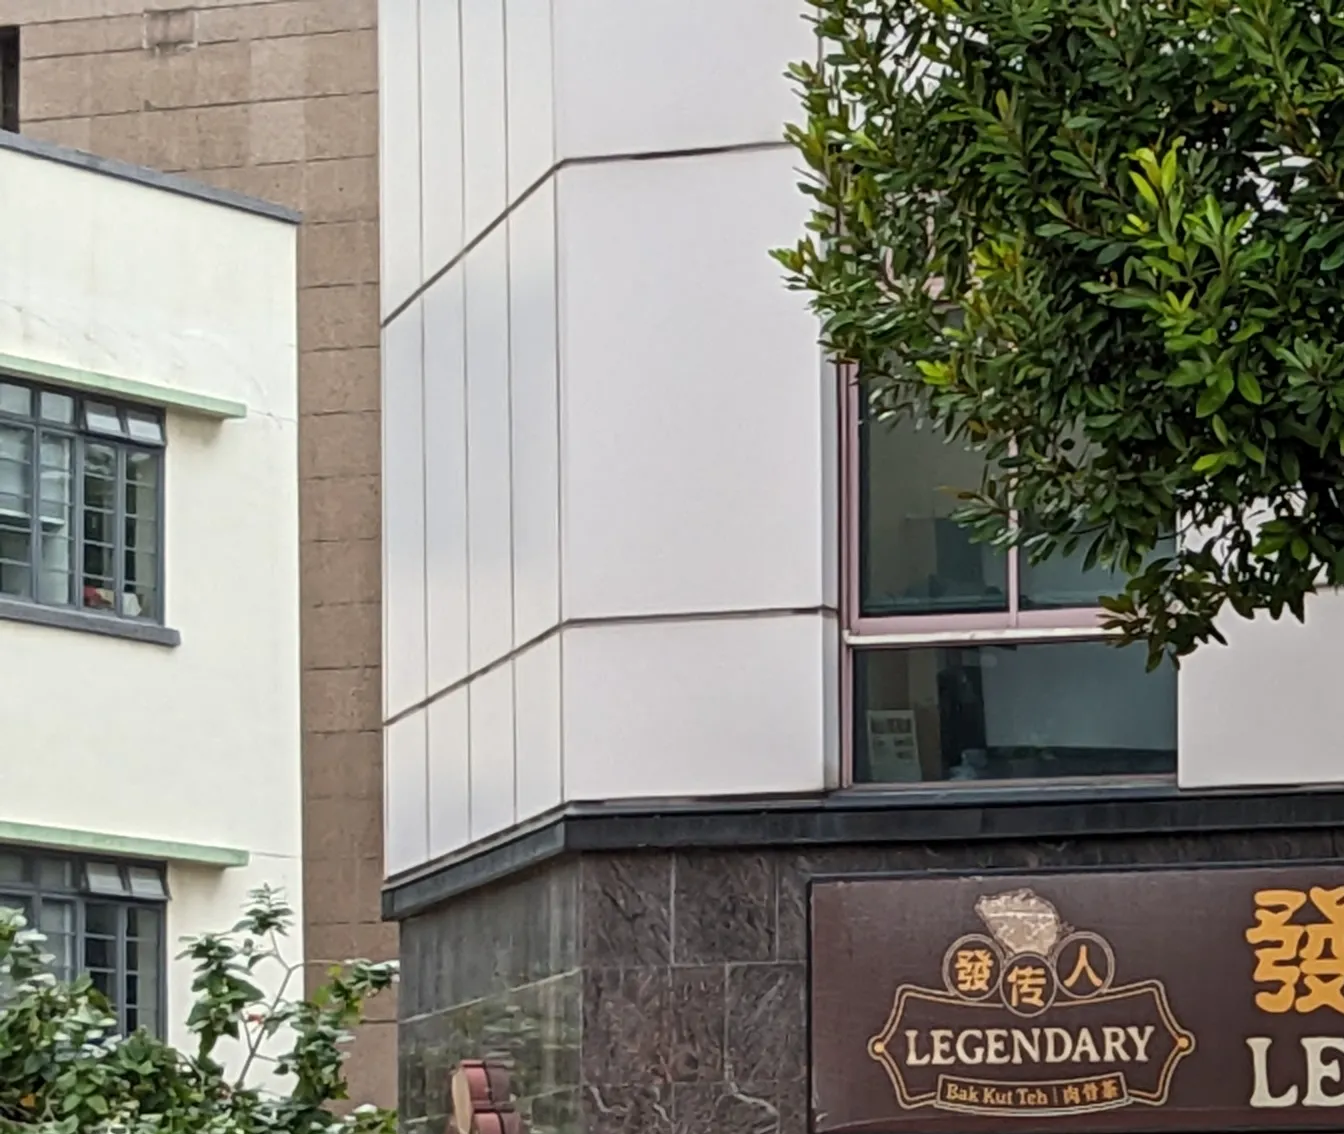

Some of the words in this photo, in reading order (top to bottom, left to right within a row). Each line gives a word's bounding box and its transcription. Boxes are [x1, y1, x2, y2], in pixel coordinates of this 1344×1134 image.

[905, 1025, 1155, 1066] LEGENDARY
[946, 1081, 978, 1102] Bak
[983, 1085, 1013, 1105] Kut
[1016, 1087, 1048, 1106] Teh
[1062, 1079, 1121, 1105] 肉骨茶
